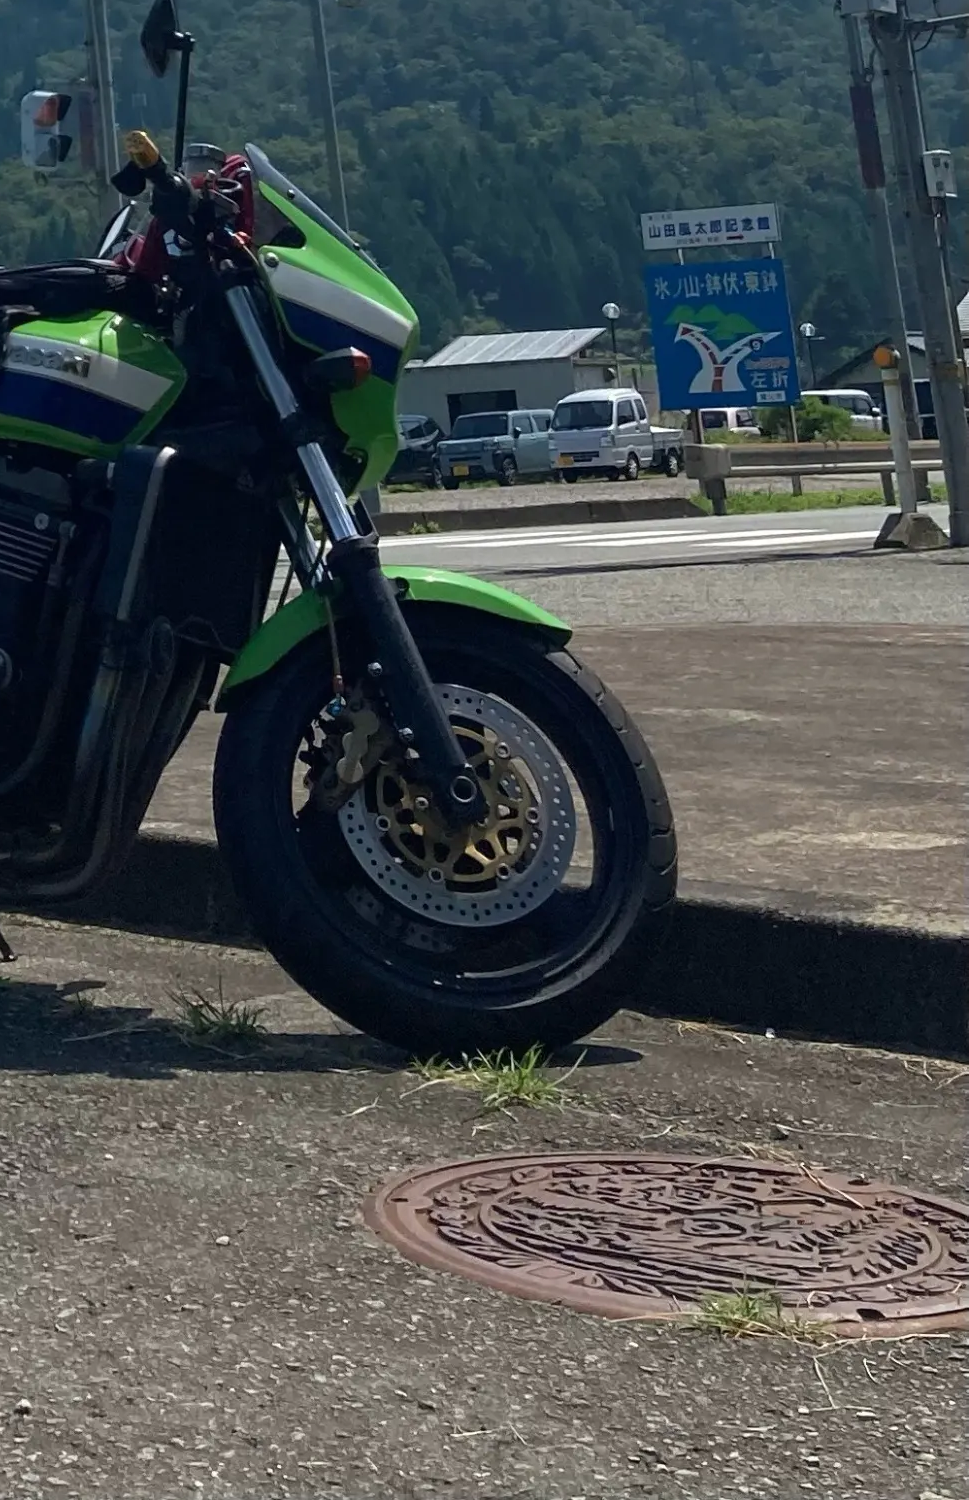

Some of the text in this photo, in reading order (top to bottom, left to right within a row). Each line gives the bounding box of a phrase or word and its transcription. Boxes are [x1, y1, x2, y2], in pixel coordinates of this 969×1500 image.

[752, 340, 761, 351] 9
[8, 345, 91, 378] asaki
[750, 371, 788, 388] 左折
